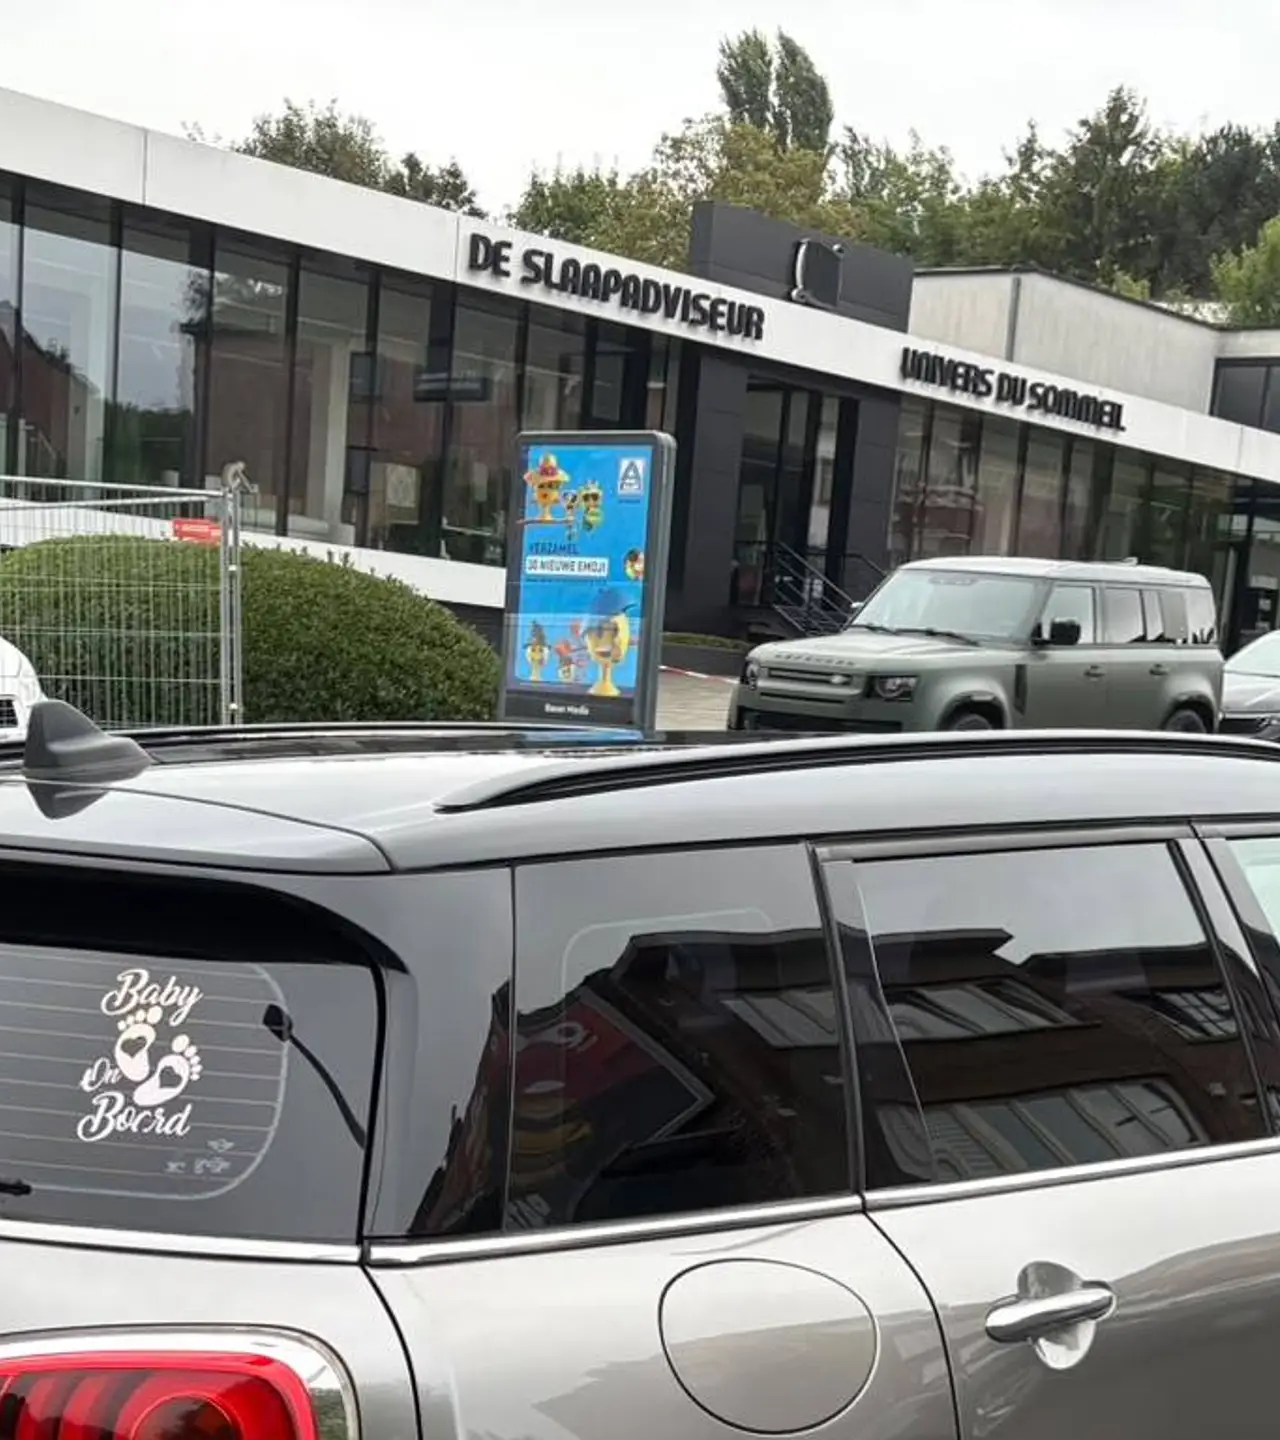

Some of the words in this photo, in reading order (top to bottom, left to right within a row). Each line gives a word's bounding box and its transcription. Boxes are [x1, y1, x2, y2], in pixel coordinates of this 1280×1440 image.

[469, 232, 512, 277] DE
[520, 248, 765, 340] SLAAPADVISEUR
[900, 347, 995, 397] UNIVERS
[995, 371, 1027, 406] DU
[1027, 382, 1126, 432] SOMMEIL
[540, 559, 576, 572] NIEUWE
[101, 967, 204, 1027] Baby
[80, 1057, 122, 1092] On
